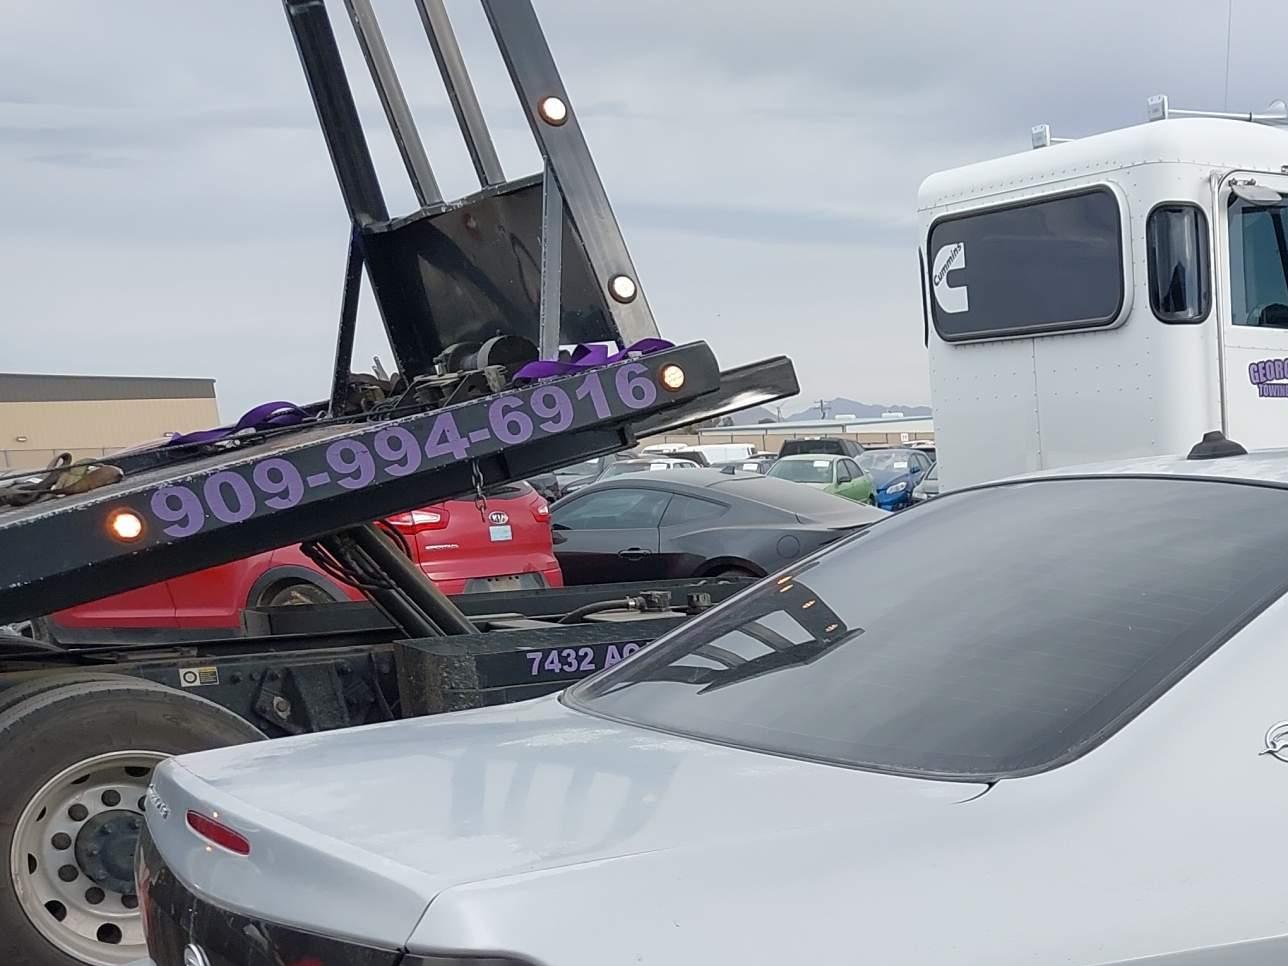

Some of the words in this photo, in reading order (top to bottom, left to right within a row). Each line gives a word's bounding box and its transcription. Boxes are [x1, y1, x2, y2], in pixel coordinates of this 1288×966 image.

[933, 243, 962, 287] Cummins
[150, 362, 658, 538] 909-994-6916
[526, 647, 596, 676] 7432
